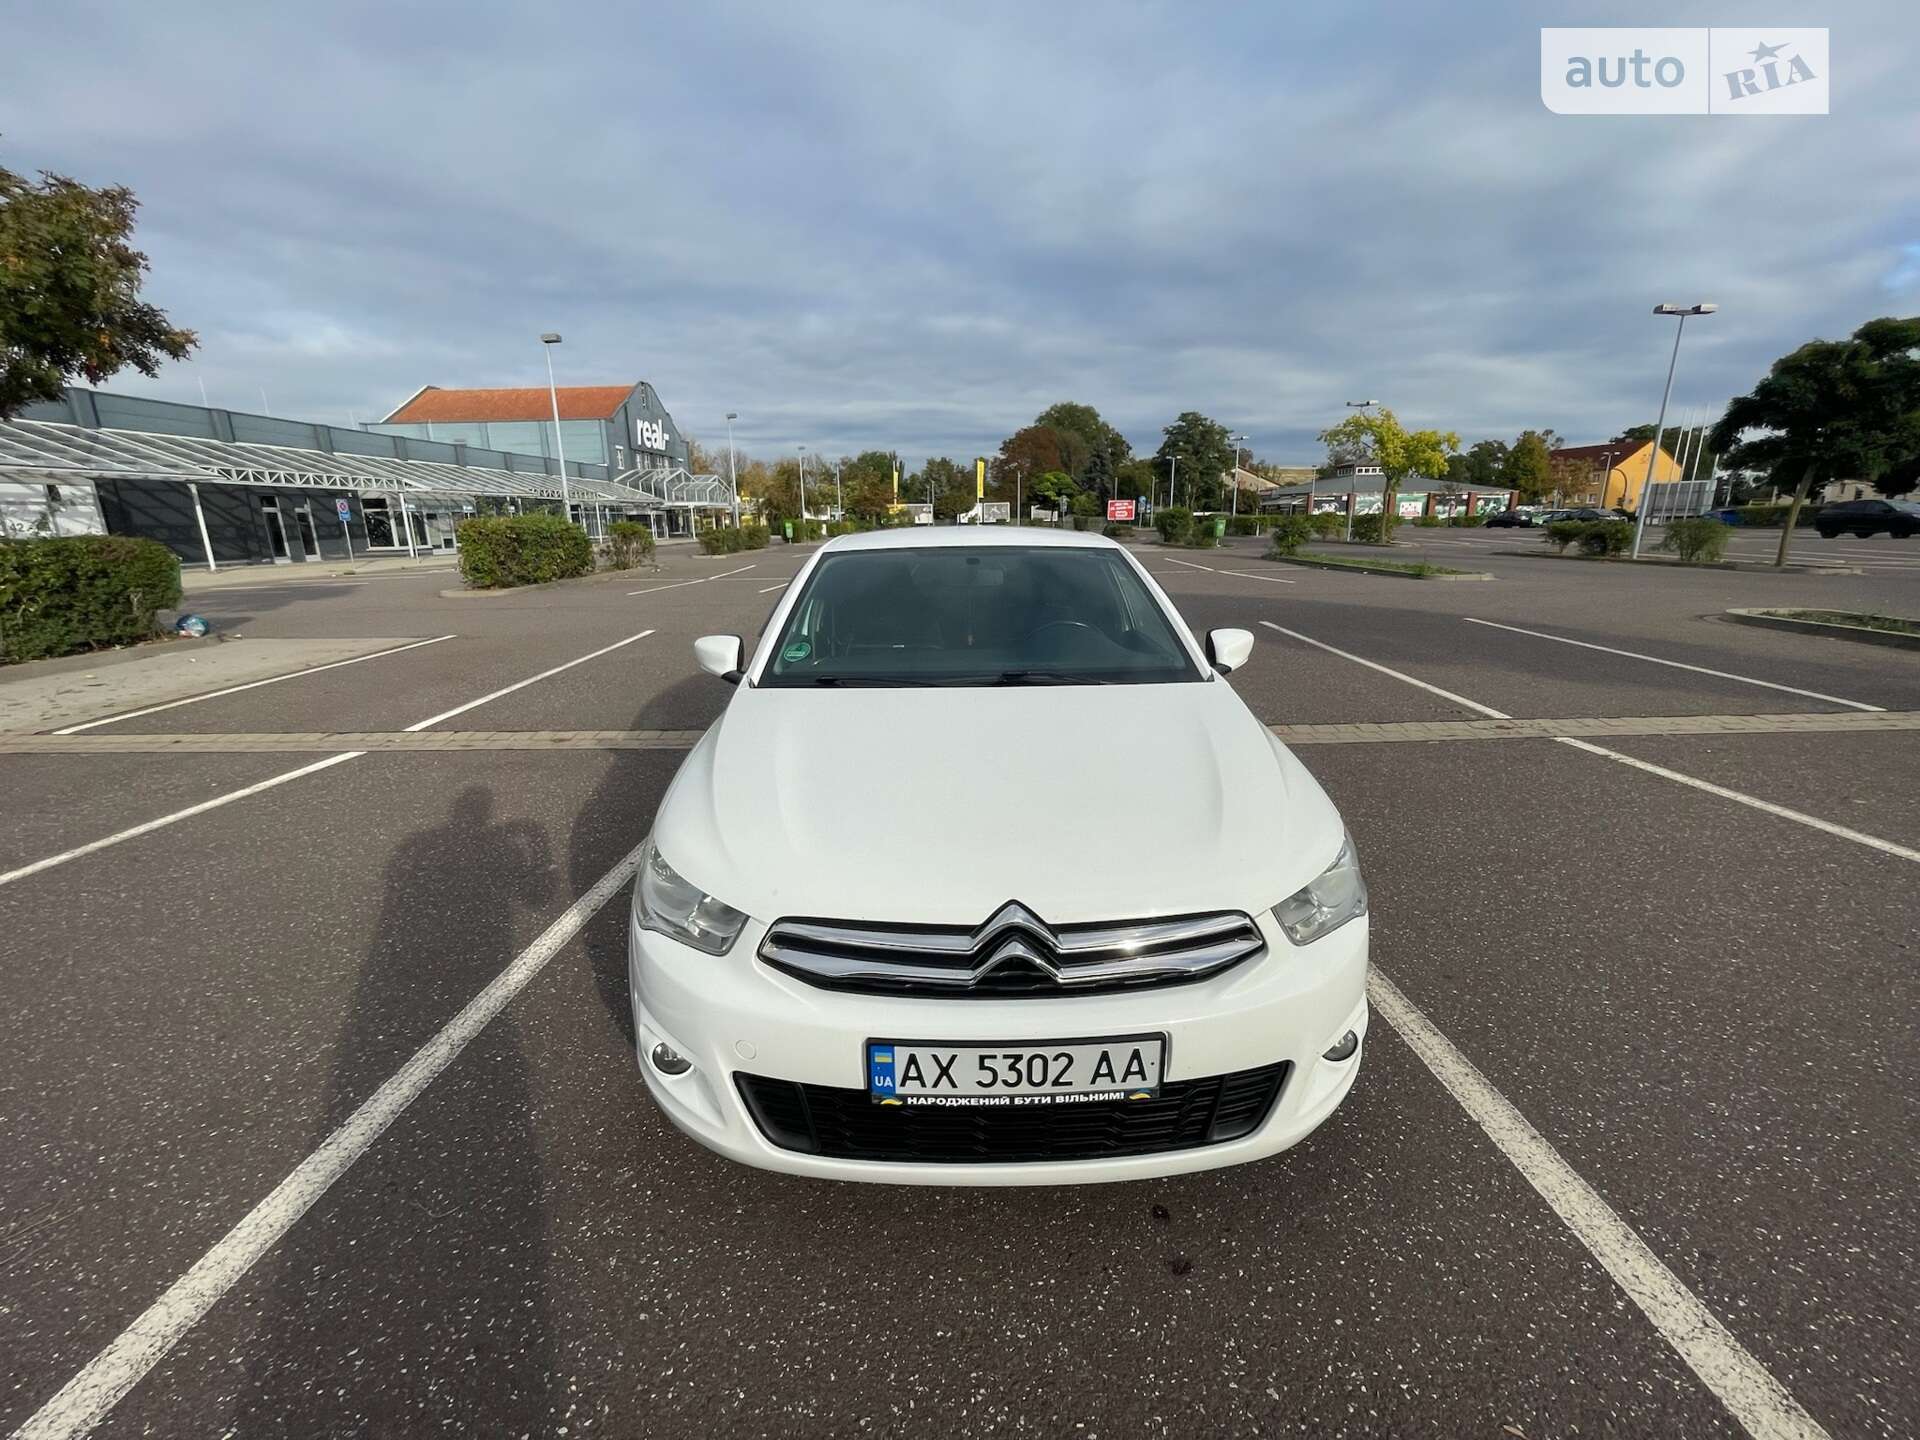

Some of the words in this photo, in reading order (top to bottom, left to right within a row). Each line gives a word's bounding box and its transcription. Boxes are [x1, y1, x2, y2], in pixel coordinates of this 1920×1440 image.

[899, 1053, 959, 1089] AX
[975, 1052, 1075, 1088] 5302
[1090, 1048, 1148, 1085] AA
[874, 1075, 894, 1088] UA
[906, 1094, 1012, 1107] НАРОДЖЕНИЙ
[1013, 1094, 1052, 1105] БУТИ
[1055, 1091, 1125, 1104] ВІЛЬНИМ!
